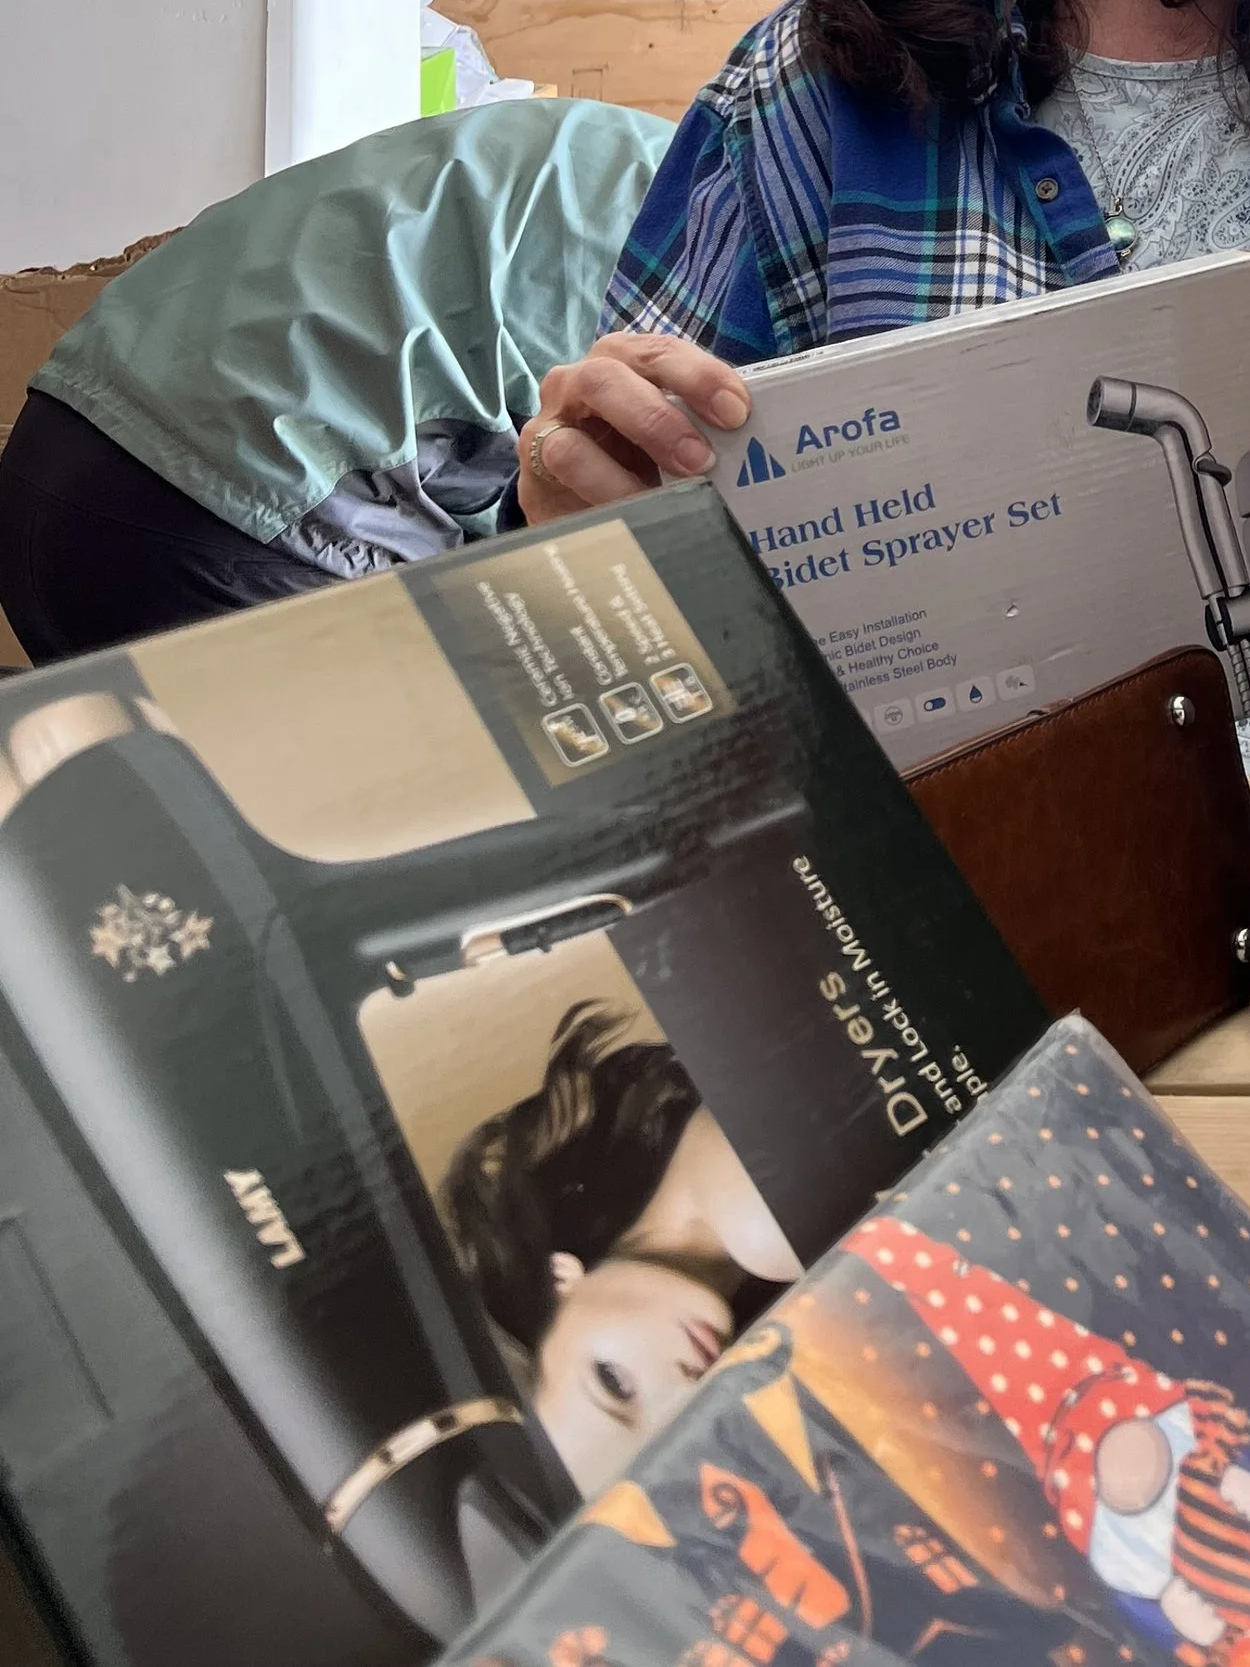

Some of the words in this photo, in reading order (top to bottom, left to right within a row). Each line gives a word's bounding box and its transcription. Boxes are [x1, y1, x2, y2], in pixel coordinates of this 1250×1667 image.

[791, 455, 824, 473] LIGHT
[828, 449, 845, 463] UP
[848, 439, 883, 457] YOUR
[885, 434, 910, 449] LIFE
[796, 408, 901, 454] Arofa
[749, 507, 844, 554] Hand
[854, 483, 936, 528] Held
[862, 512, 996, 567] Sprayer
[1007, 492, 1062, 527] Set
[829, 628, 859, 643] Easy
[863, 609, 928, 634] Installation
[845, 640, 877, 657] Bidet
[879, 629, 921, 647] Design
[512, 643, 557, 707] Ceramic
[836, 665, 845, 677] &
[848, 654, 894, 674] Healthy
[898, 642, 939, 659] Choice
[843, 673, 890, 693] tainless
[893, 662, 924, 679] Steel
[927, 654, 957, 671] Body
[792, 855, 871, 972] Moisture
[866, 971, 891, 1001] in
[819, 971, 928, 1136] Dryers
[882, 998, 929, 1063] Lock
[917, 1061, 962, 1114] and
[952, 1045, 988, 1102] ple.
[223, 1168, 306, 1270] LAMY
